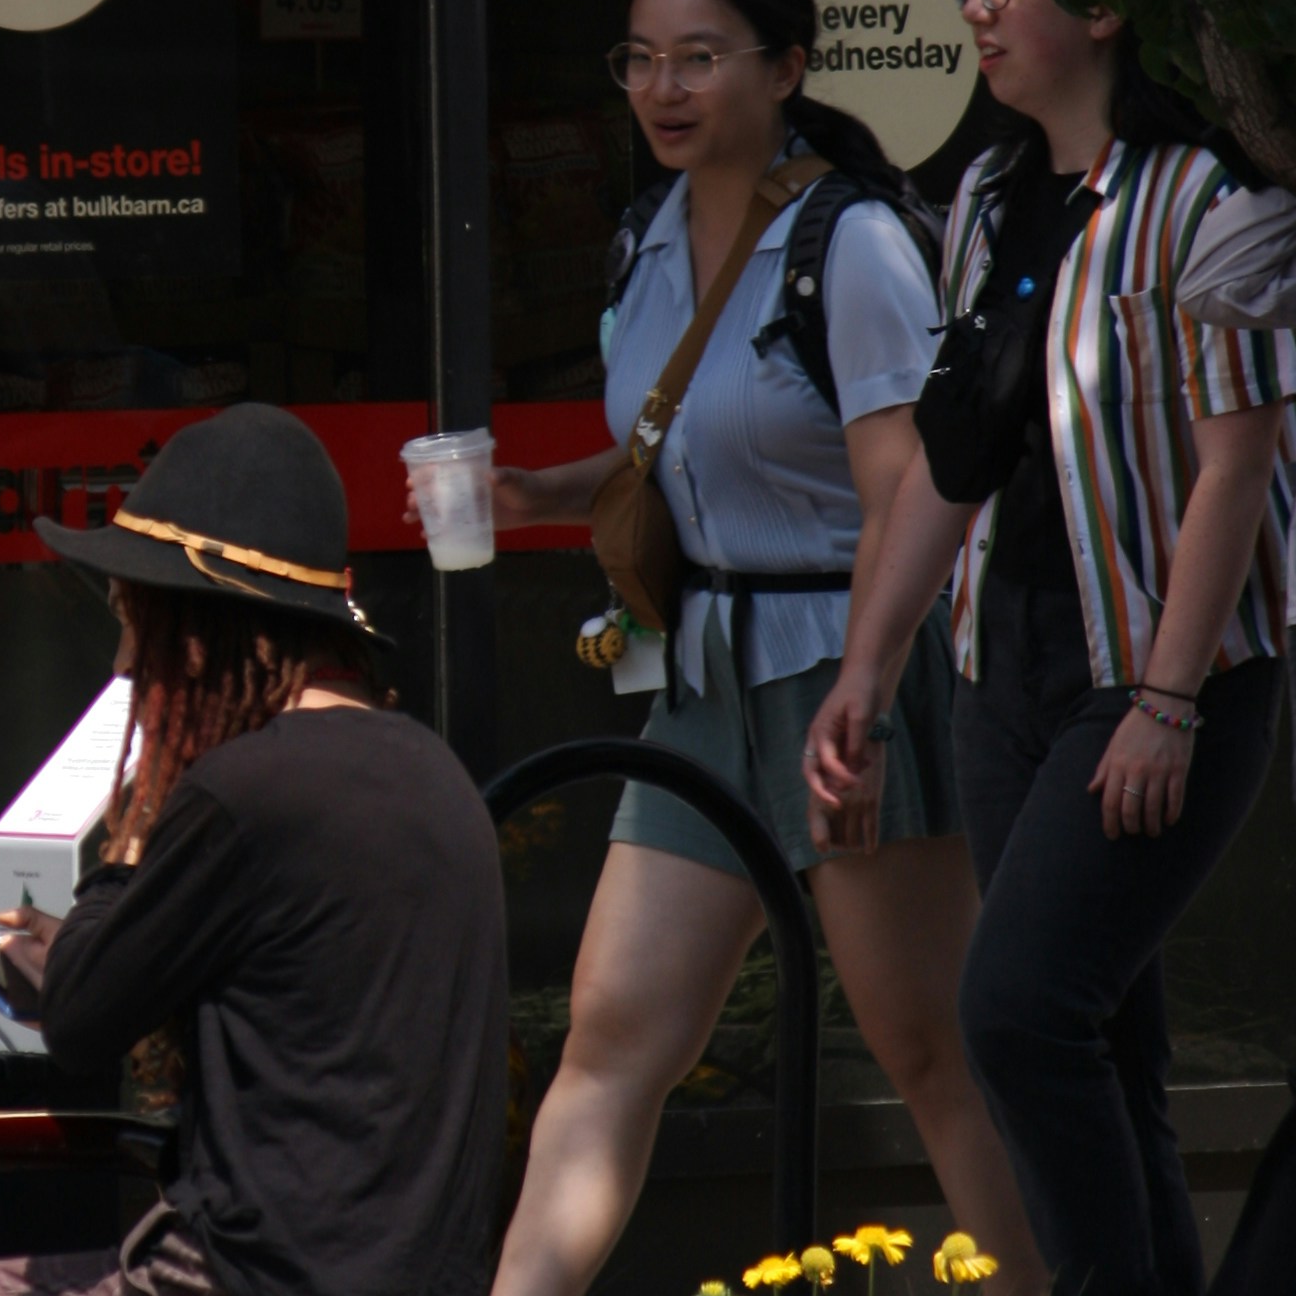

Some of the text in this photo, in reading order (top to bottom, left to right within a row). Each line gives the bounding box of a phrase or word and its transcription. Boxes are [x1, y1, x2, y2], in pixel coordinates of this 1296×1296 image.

[822, 3, 910, 35] every
[806, 37, 963, 74] ednesday
[40, 139, 203, 180] in-store!
[44, 199, 67, 218] at
[73, 196, 205, 217] bulkbarn.ca
[6, 242, 38, 255] regular
[40, 241, 63, 252] retail
